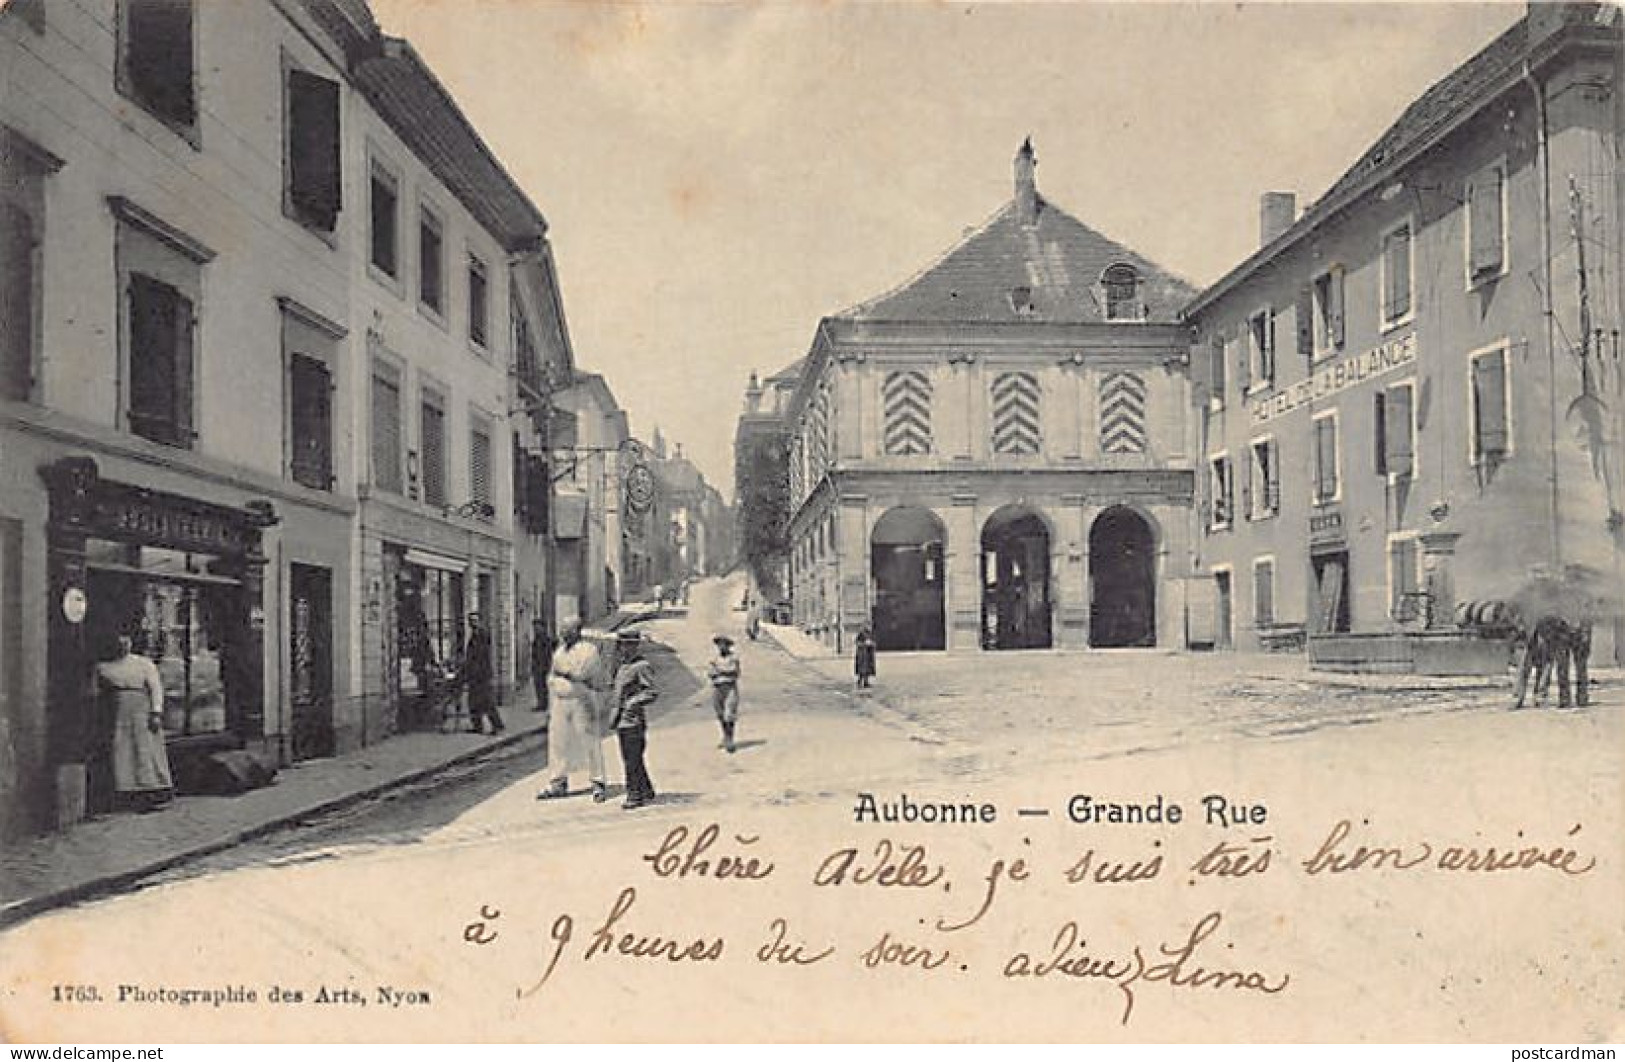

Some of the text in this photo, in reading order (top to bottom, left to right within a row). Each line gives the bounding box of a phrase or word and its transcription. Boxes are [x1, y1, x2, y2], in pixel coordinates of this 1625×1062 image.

[1334, 333, 1414, 391] BALANCE
[936, 838, 1030, 931] je
[1064, 840, 1164, 883] suis
[1301, 819, 1432, 875] bien
[1437, 823, 1596, 875] arrivée
[463, 904, 501, 945] à
[517, 914, 573, 999] 9
[585, 887, 724, 961] heures
[756, 918, 834, 965] du
[1143, 911, 1290, 993] Lina
